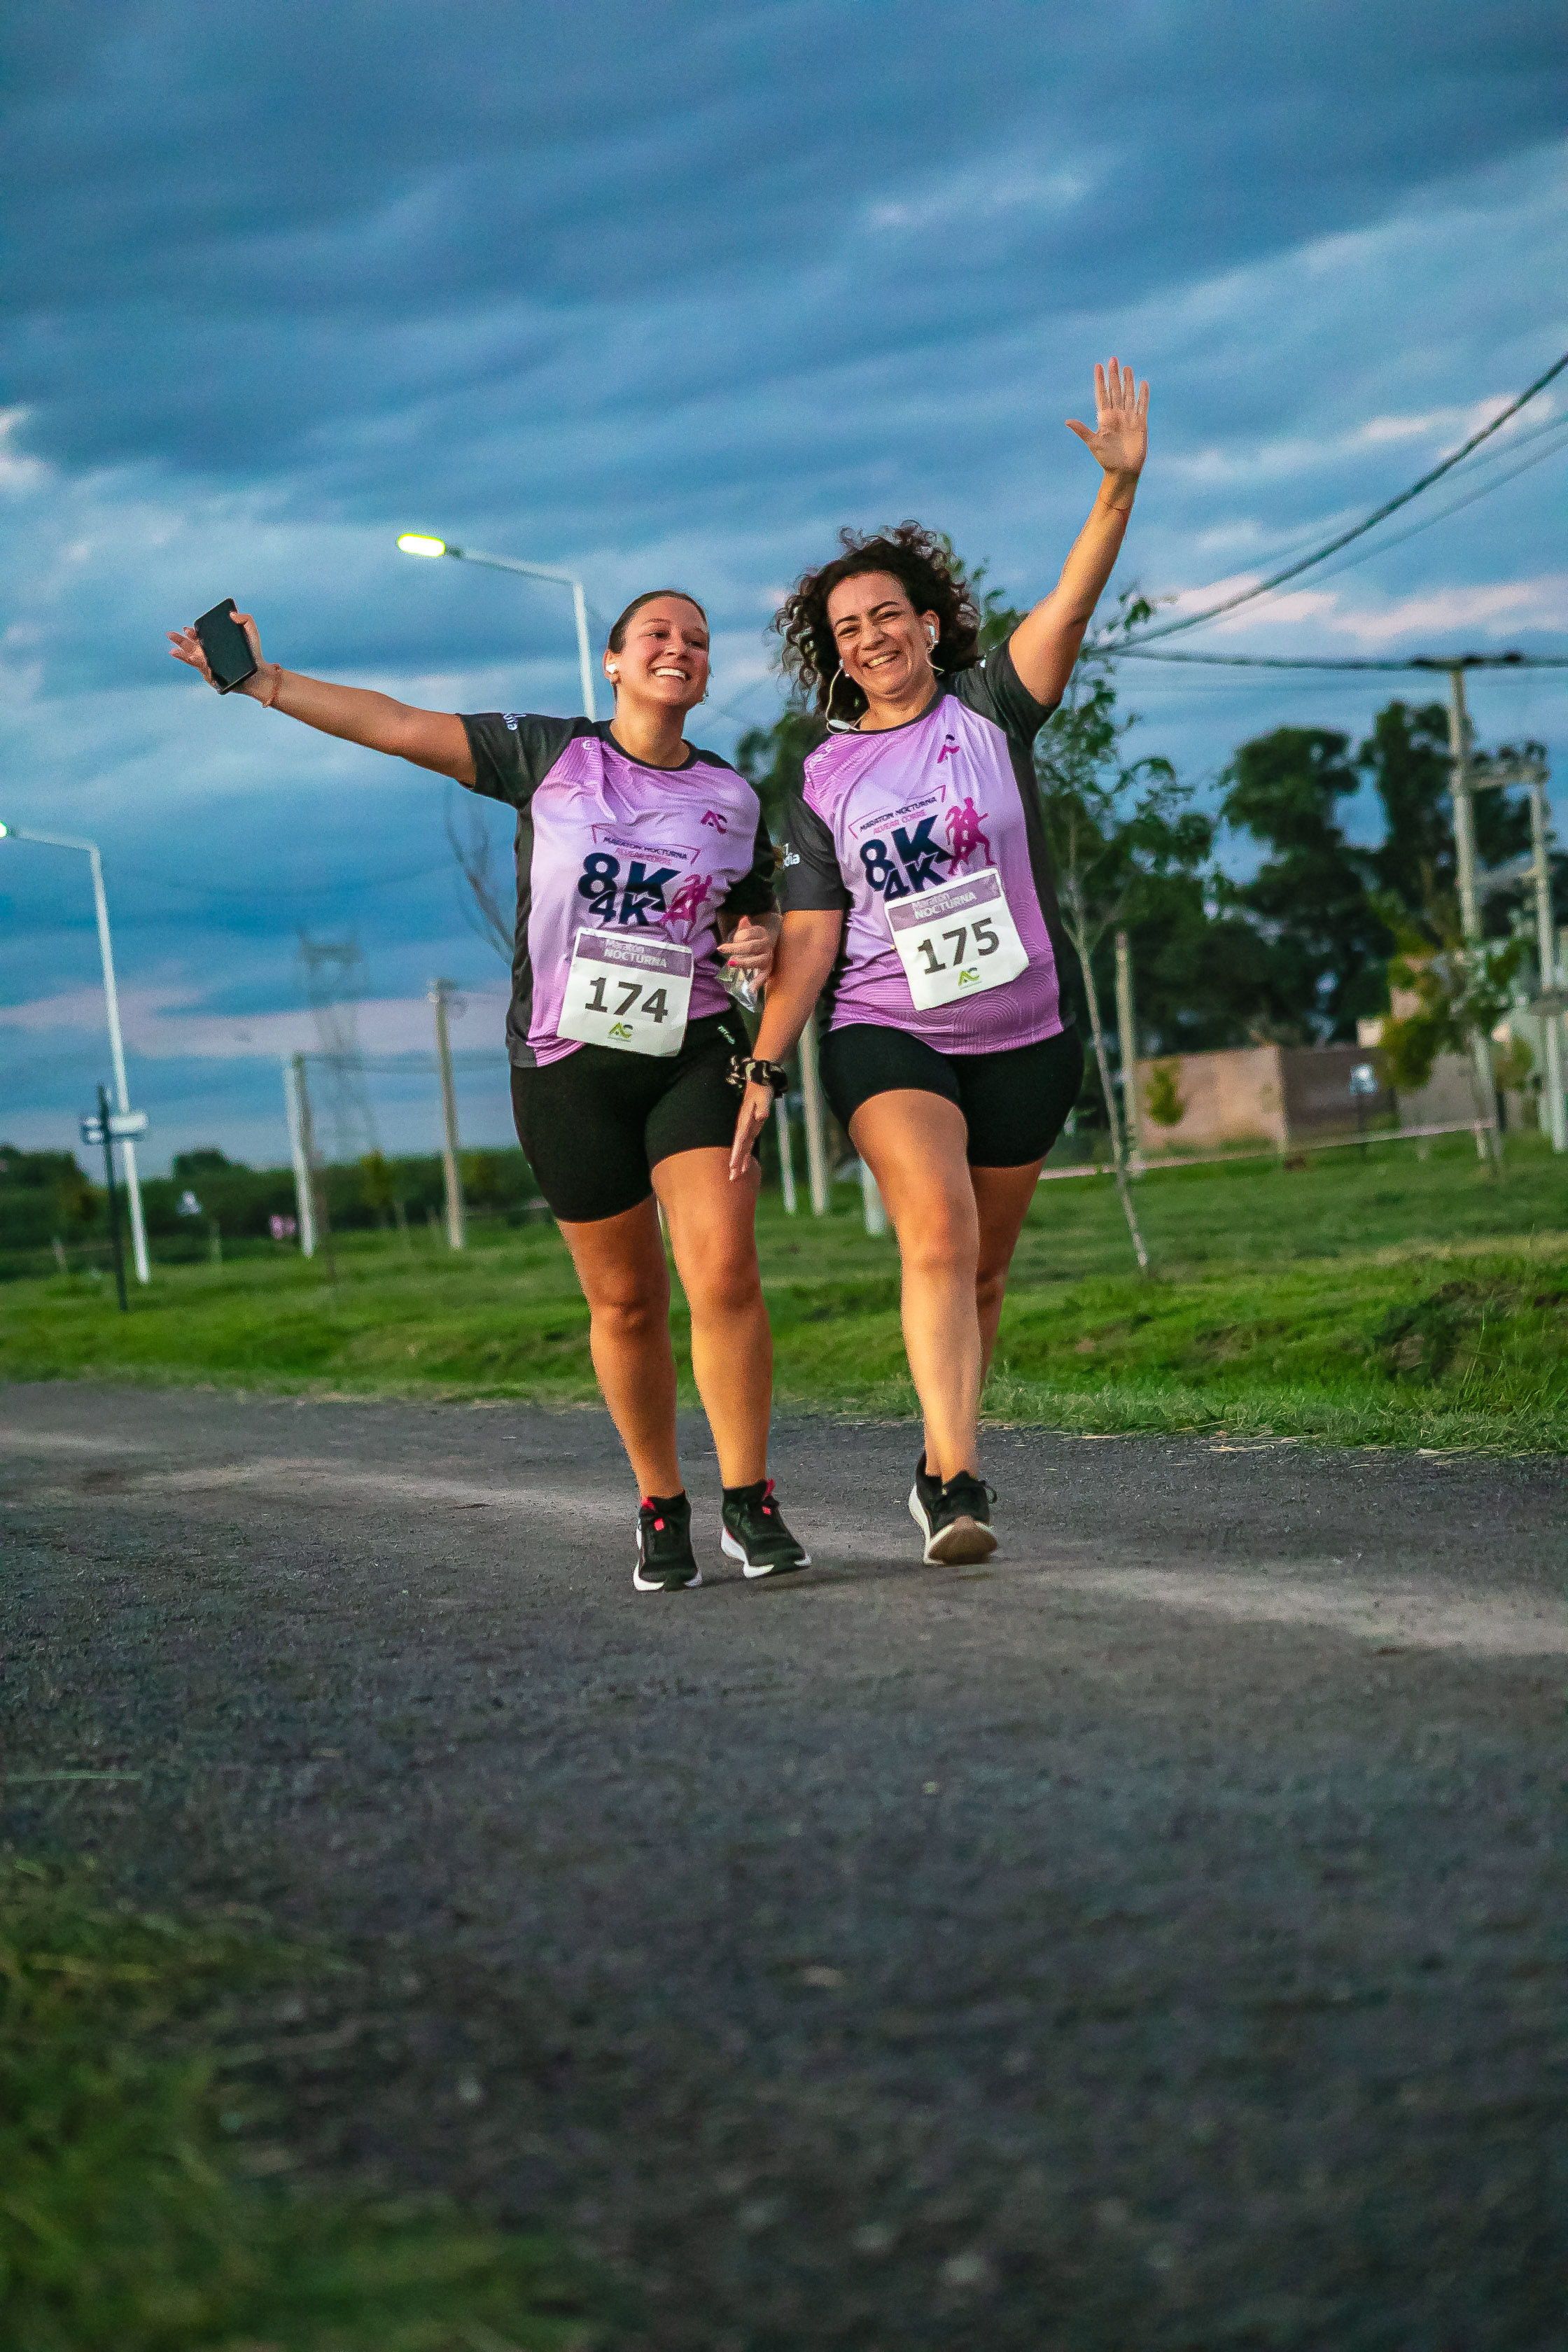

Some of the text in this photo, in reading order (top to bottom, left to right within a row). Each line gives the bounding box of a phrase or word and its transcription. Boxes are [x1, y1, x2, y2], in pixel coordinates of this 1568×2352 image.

[895, 797, 937, 816] NOCTURNA
[860, 815, 953, 891] 8K
[578, 853, 682, 912] 8K
[884, 853, 947, 902] 4K
[589, 890, 661, 925] 4K
[913, 891, 977, 920] NOCTURNA
[604, 946, 667, 968] NOCTURNA
[917, 917, 1000, 974] 175
[584, 977, 668, 1023] 174
